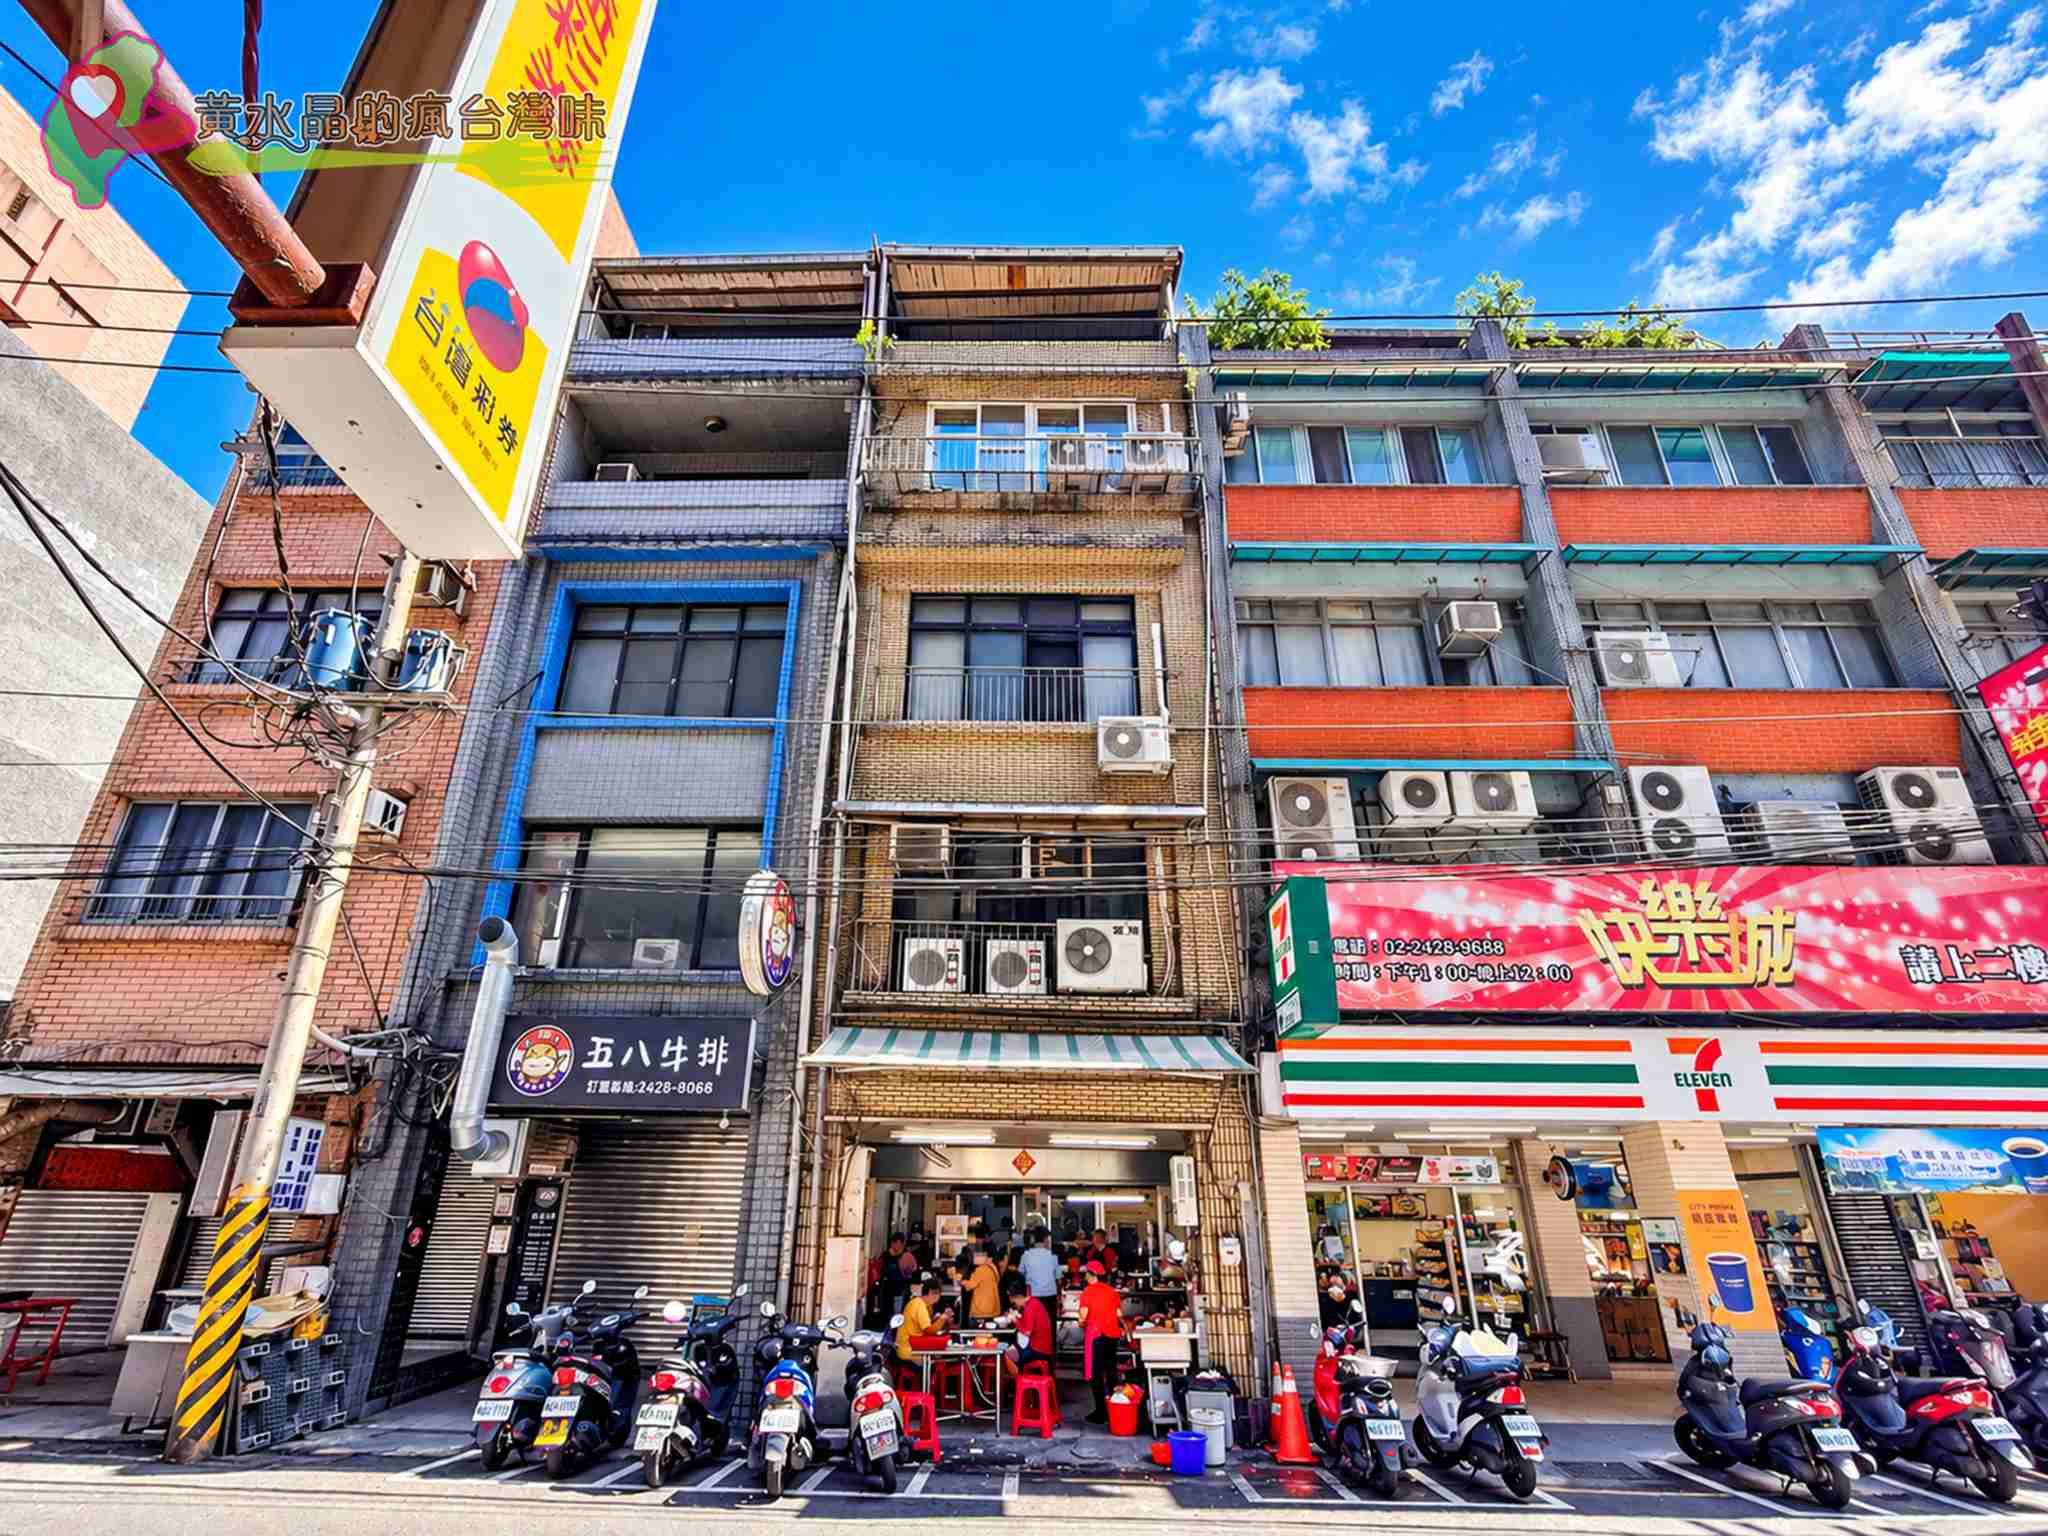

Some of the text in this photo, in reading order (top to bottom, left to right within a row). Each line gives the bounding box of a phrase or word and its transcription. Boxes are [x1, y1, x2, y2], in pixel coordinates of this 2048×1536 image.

[1577, 878, 1796, 989] 快樂城
[581, 1035, 729, 1076] 五八牛排
